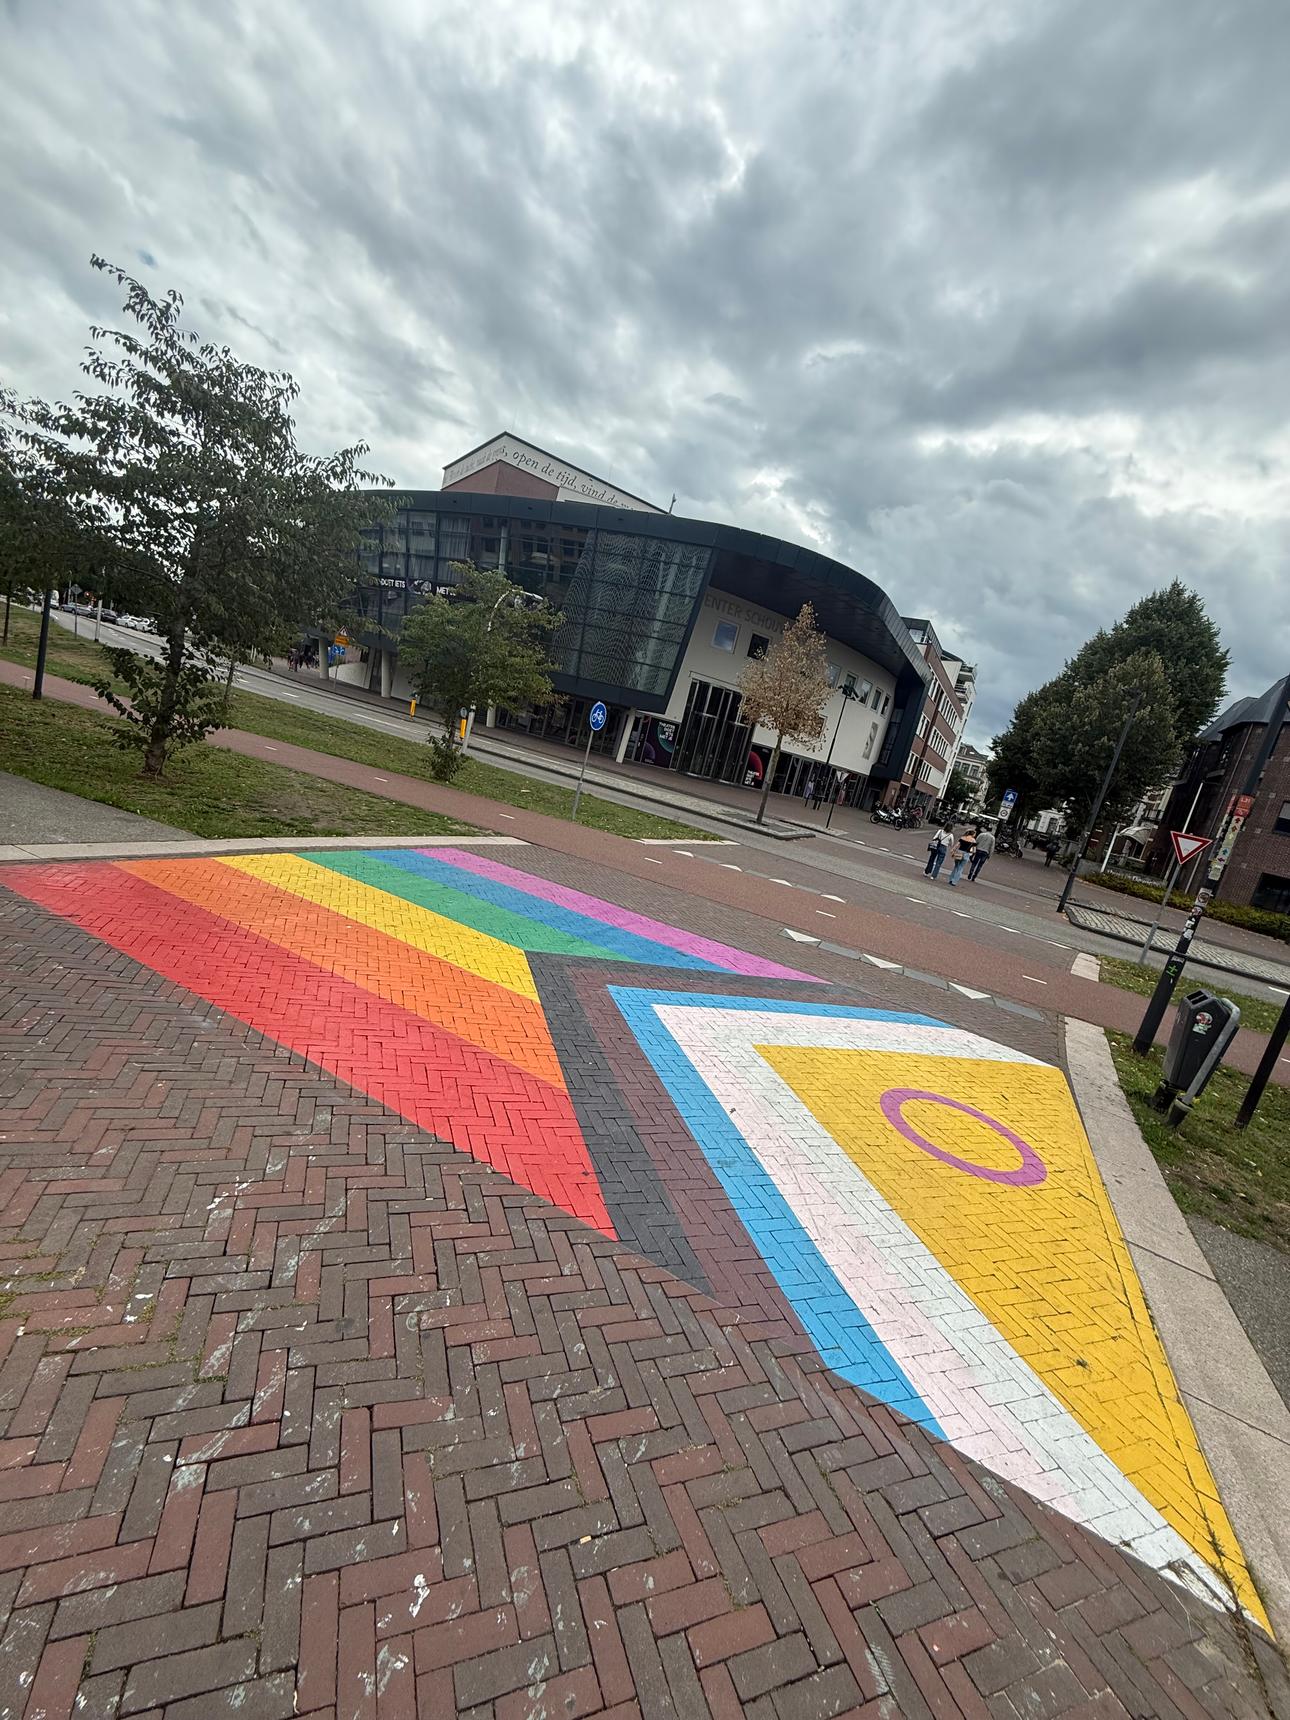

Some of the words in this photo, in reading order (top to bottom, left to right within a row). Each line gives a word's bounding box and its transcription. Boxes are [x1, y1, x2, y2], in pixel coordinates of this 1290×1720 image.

[512, 451, 539, 469] open
[541, 463, 555, 476] de
[556, 471, 577, 489] tijd,
[581, 484, 607, 500] vind
